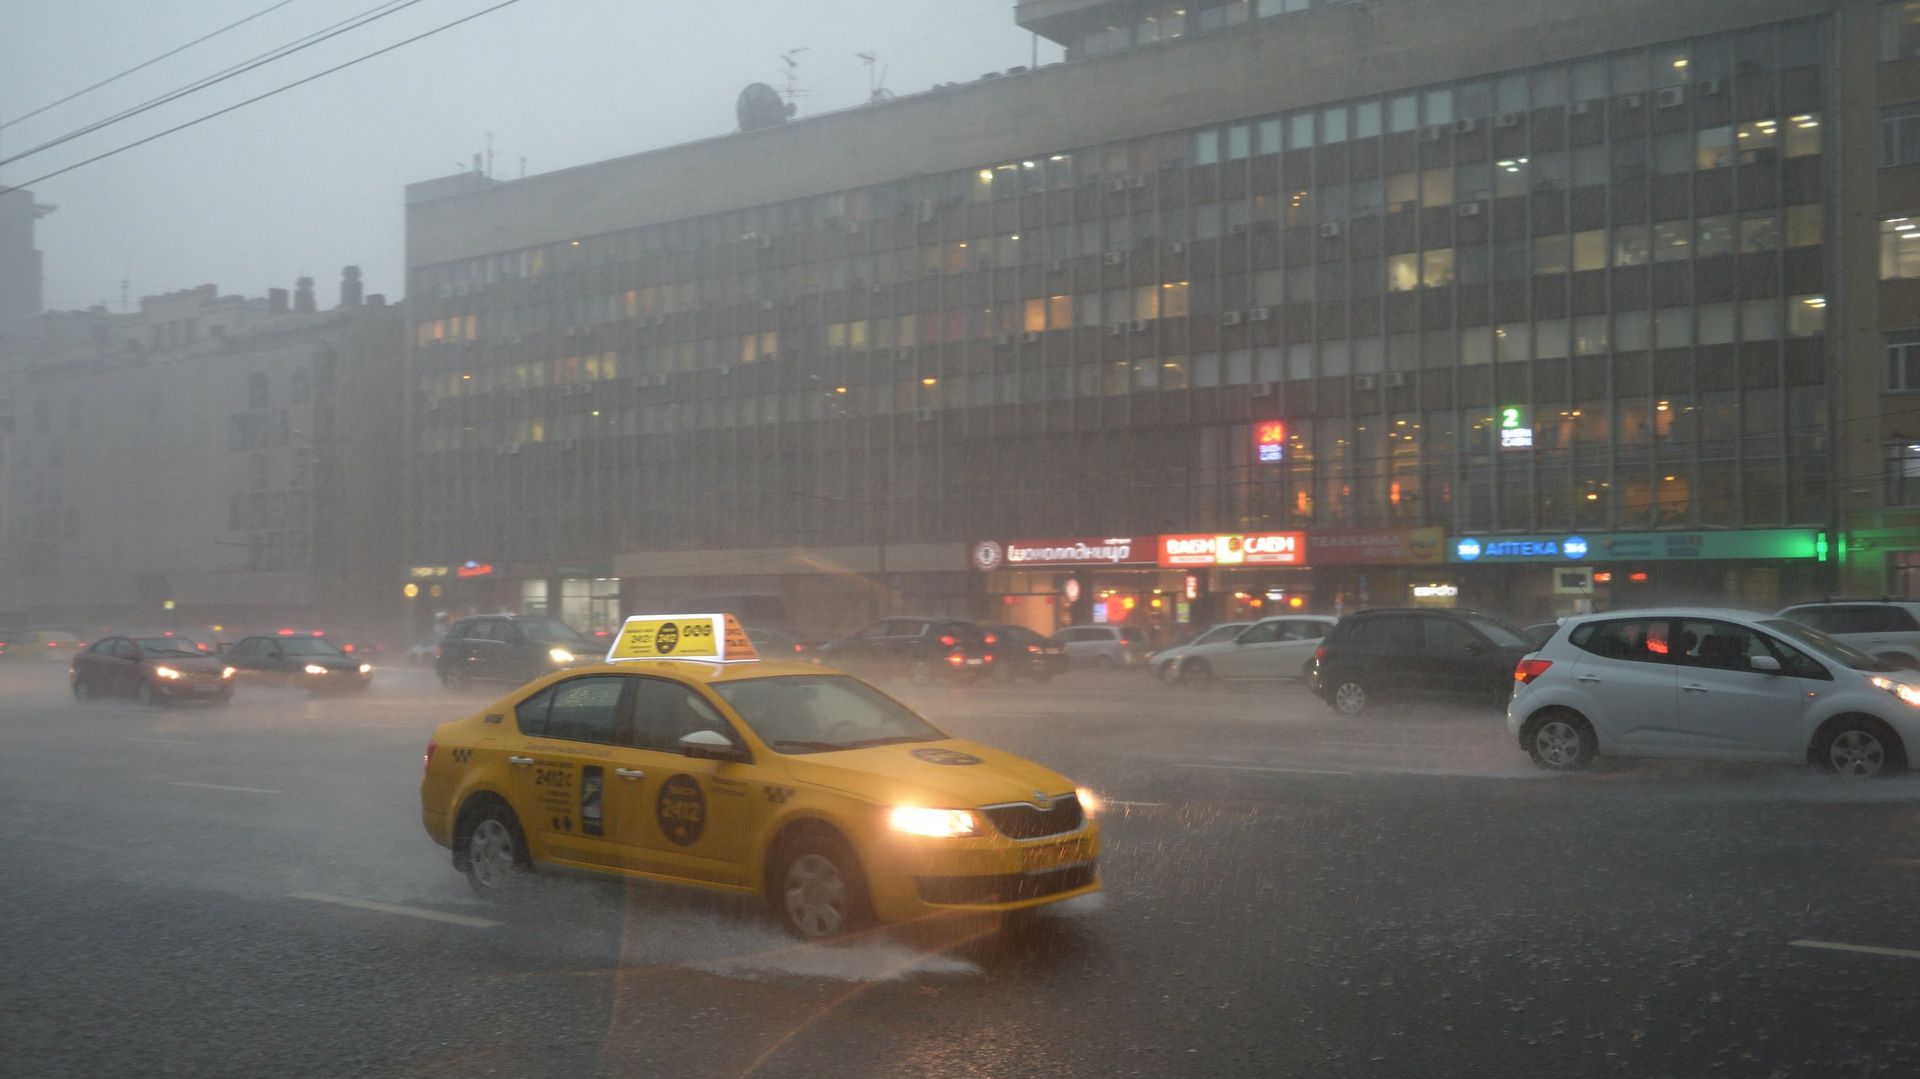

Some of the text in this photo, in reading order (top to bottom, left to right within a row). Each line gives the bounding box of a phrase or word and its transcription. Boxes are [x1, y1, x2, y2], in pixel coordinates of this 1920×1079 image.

[1502, 408, 1519, 428] 2
[1259, 423, 1283, 443] 24
[1485, 541, 1559, 556] АПТЕКА
